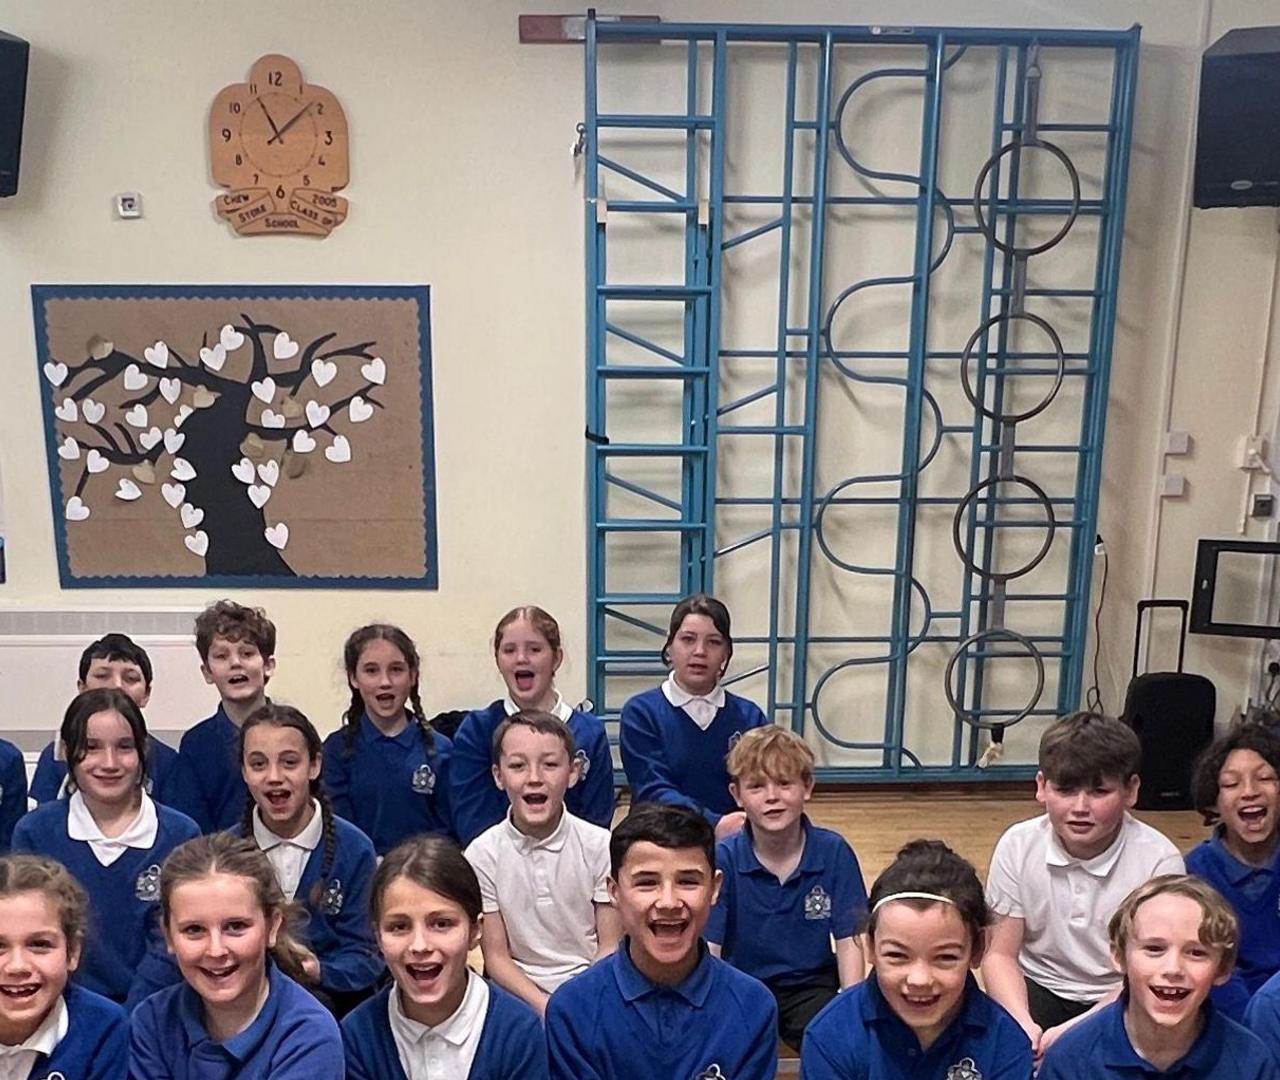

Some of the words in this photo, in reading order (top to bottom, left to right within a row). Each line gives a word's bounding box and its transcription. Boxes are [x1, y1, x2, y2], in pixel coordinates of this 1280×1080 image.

[269, 71, 283, 87] 12
[249, 84, 258, 95] 11
[229, 103, 241, 114] 10
[317, 103, 324, 115] 2
[221, 128, 232, 143] 9
[324, 130, 333, 146] 3
[235, 154, 243, 166] 8
[318, 154, 326, 166] 4
[253, 174, 259, 185] 7
[303, 174, 310, 186] 5
[275, 184, 285, 199] 6
